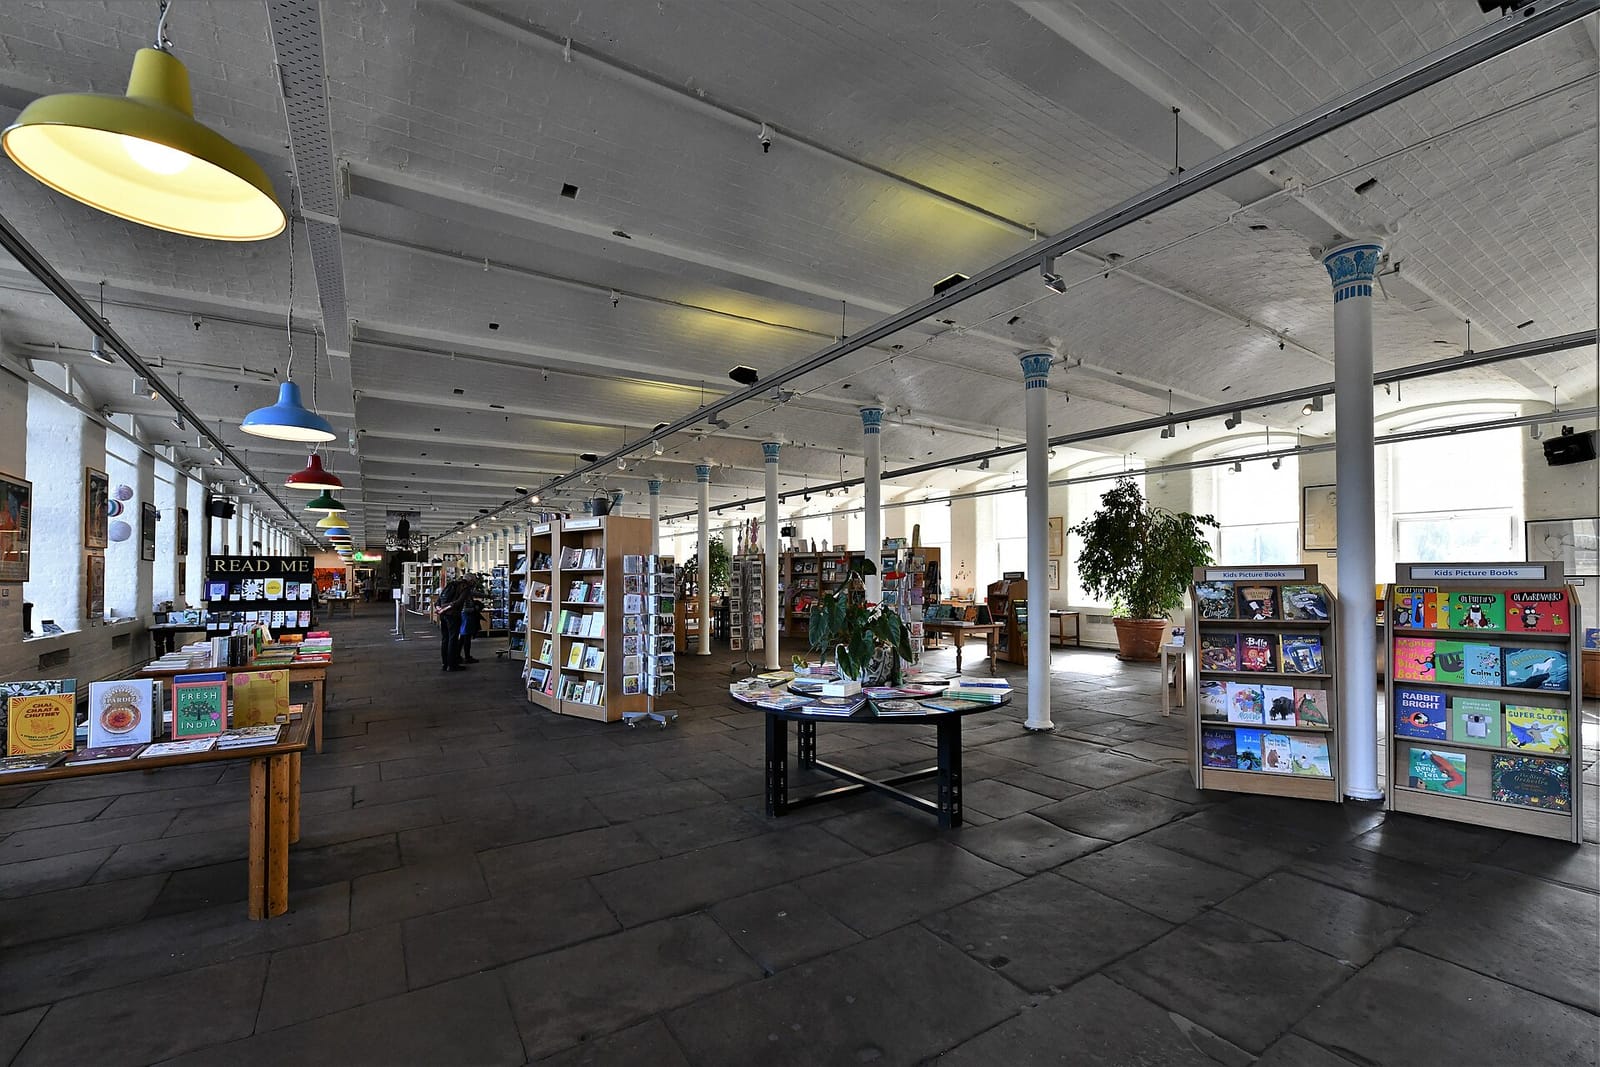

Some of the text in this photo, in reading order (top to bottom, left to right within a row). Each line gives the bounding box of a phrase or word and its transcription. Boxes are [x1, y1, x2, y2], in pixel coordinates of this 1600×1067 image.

[214, 560, 309, 572] READ ME
[1490, 569, 1519, 577] Books
[1397, 640, 1433, 648] Monke
[1398, 669, 1433, 681] Botto
[1470, 669, 1492, 677] Calm
[181, 692, 217, 701] FRESH
[1402, 692, 1441, 702] RABBIT
[1402, 700, 1440, 709] BRIGHT
[1508, 711, 1565, 722] SUPER SLOTH
[181, 720, 217, 729] INDIA
